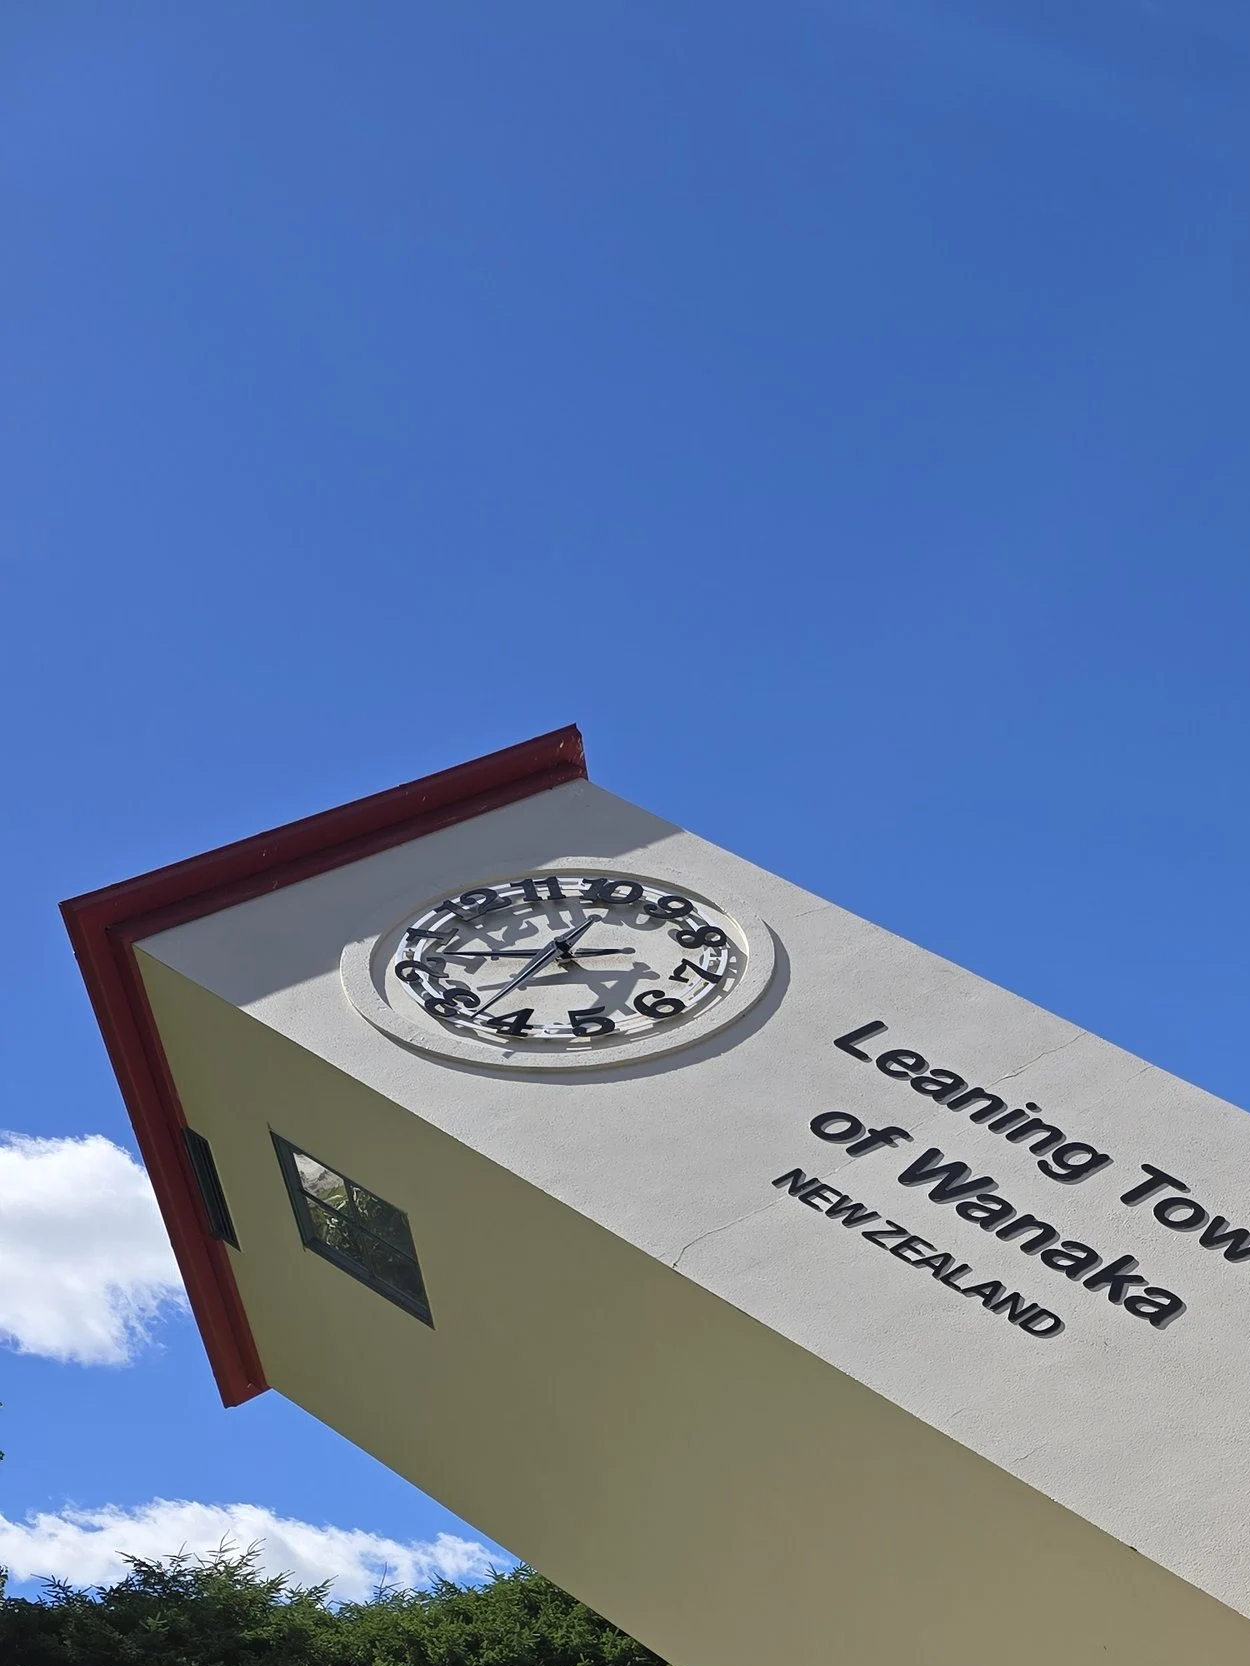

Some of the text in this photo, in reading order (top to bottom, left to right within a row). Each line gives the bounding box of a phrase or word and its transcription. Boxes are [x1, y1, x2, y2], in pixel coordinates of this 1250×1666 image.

[510, 876, 567, 902] 11
[579, 878, 643, 904] 10
[434, 888, 512, 921] 12
[644, 896, 694, 919] 9
[406, 927, 459, 945] 1
[676, 926, 727, 949] 8
[395, 957, 449, 982] 2
[668, 958, 722, 984] 7
[425, 988, 480, 1017] 3
[633, 990, 686, 1018] 6
[487, 1008, 535, 1037] 4
[567, 1006, 615, 1037] 5
[834, 1020, 1112, 1184] Leaning
[810, 1111, 1185, 1328] of Wanaka
[772, 1168, 1063, 1338] NEW ZEALAND
